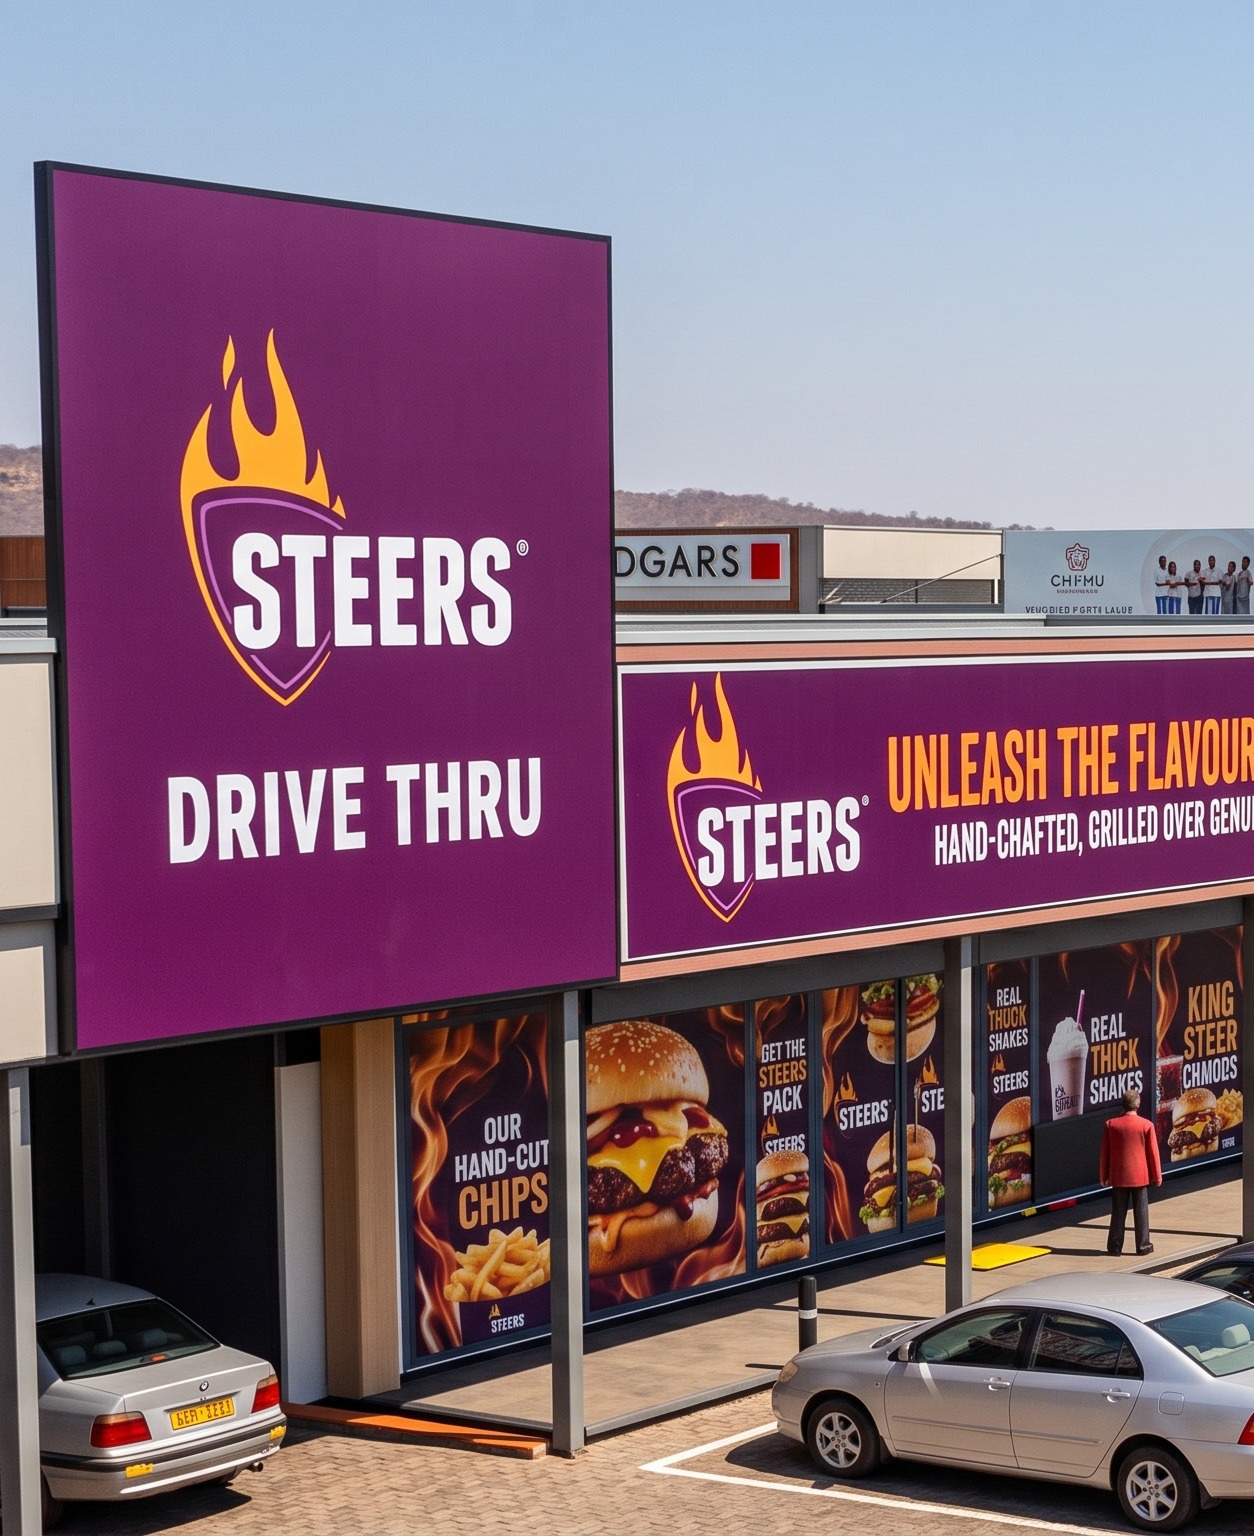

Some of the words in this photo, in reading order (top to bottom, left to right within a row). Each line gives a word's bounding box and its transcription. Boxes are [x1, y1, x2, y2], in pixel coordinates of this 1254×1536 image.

[615, 545, 740, 577] DGARS
[232, 532, 512, 649] STEERS
[888, 728, 1047, 813] UNLEASH
[1057, 724, 1119, 798] THE
[168, 766, 366, 864] DRIVE
[386, 757, 541, 846] THRU
[697, 796, 860, 887] STEERS
[934, 812, 1083, 866] HAND-CHAFTED,
[1088, 805, 1158, 849] GRILLED
[1163, 800, 1204, 841] OVER
[997, 986, 1022, 1007] REAL
[1188, 980, 1234, 1023] KING
[989, 1028, 1028, 1052] SHAKES
[1091, 1012, 1126, 1043] REAL
[1183, 1018, 1237, 1060] STEER
[761, 1042, 782, 1063] GET
[785, 1038, 806, 1058] THE
[1090, 1037, 1139, 1076] THICK
[759, 1059, 807, 1088] STEERS
[993, 1070, 1029, 1094] STEERS
[1090, 1070, 1143, 1105] SHAKES
[763, 1085, 802, 1116] PACK
[839, 1101, 888, 1131] STEERS
[922, 1088, 944, 1113] STE
[484, 1113, 521, 1144] OUR
[455, 1139, 549, 1182] HAND-CUT
[459, 1172, 548, 1229] CHIPS
